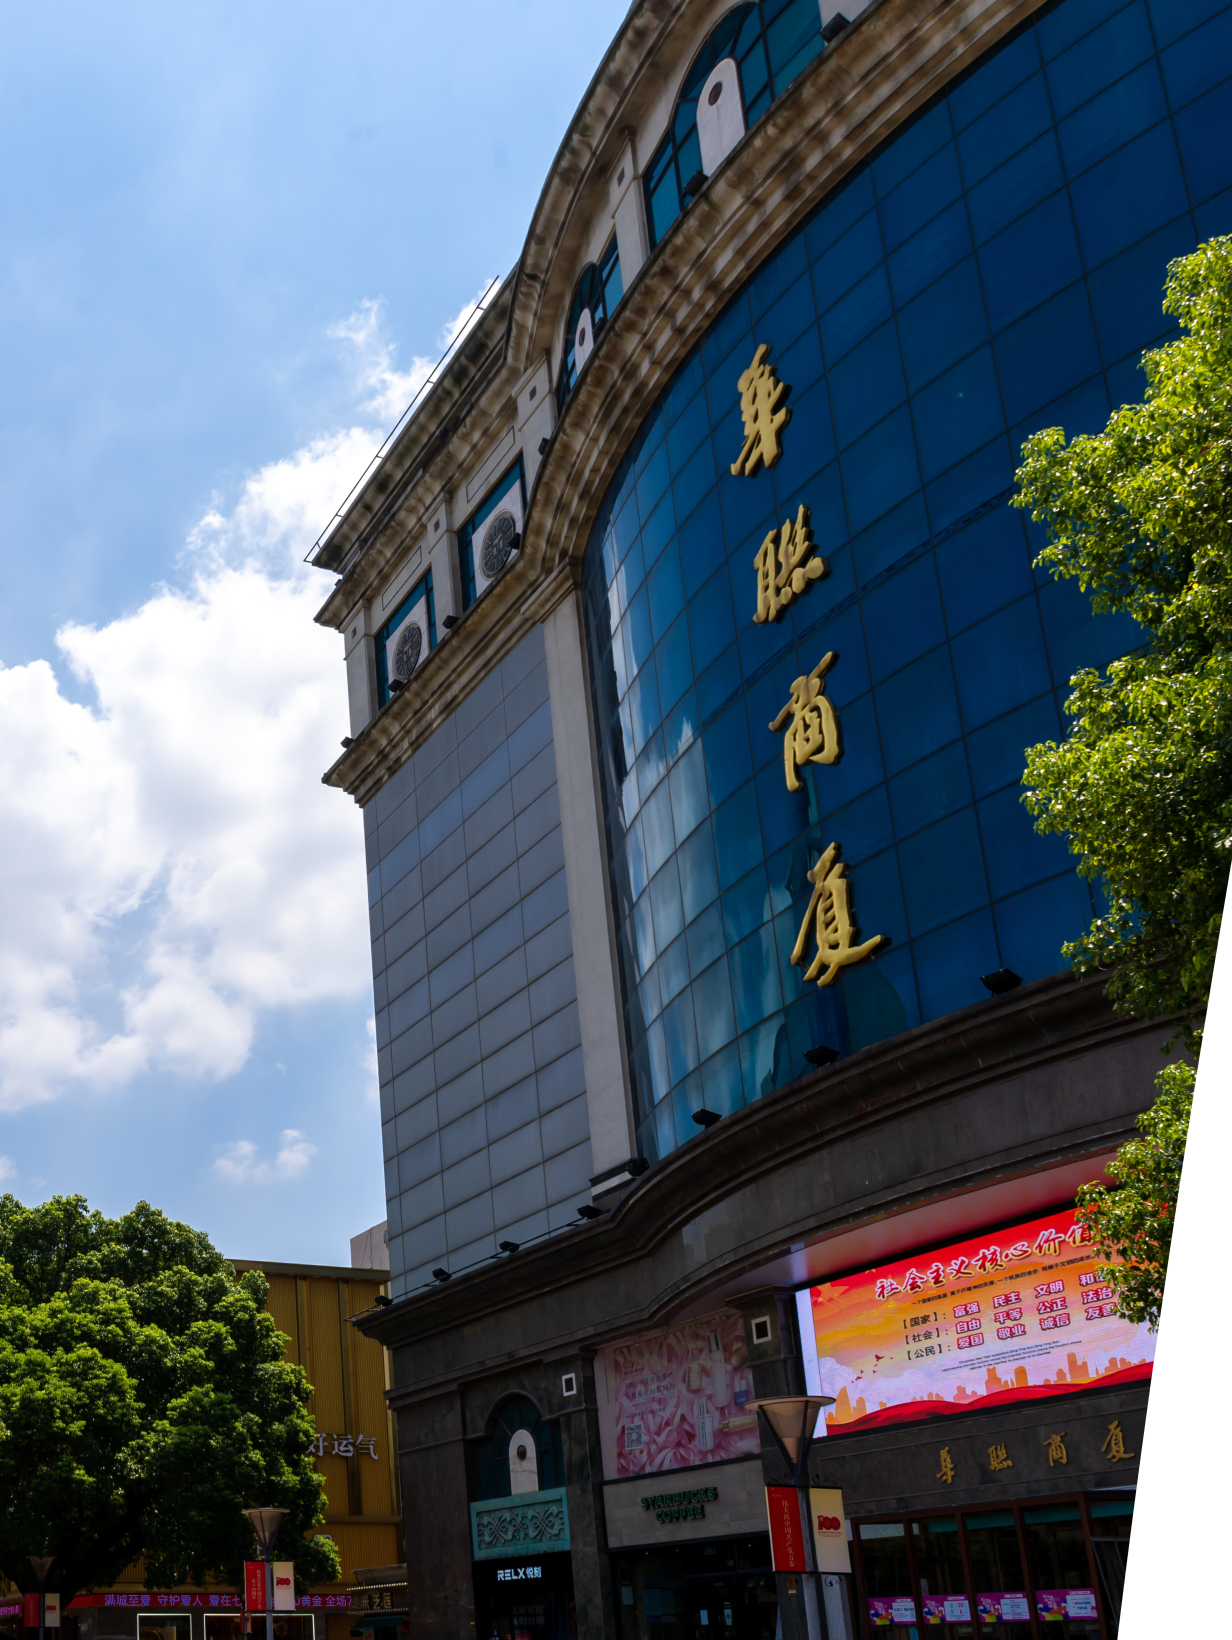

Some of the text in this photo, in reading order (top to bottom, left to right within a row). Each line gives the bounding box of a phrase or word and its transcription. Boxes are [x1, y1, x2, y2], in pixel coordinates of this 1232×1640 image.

[953, 1301, 980, 1318] 富强
[993, 1291, 1021, 1308] 民主
[1034, 1280, 1064, 1298] 文明
[955, 1318, 981, 1335] 自由
[994, 1307, 1023, 1325] 平等
[1036, 1297, 1067, 1315] 公正
[1081, 1286, 1113, 1305] 法治
[957, 1332, 984, 1350] 爱国
[996, 1323, 1026, 1340] 敬业
[1039, 1313, 1070, 1331] 诚信
[640, 1487, 717, 1509] STARBUCKS
[655, 1505, 704, 1523] COFFEE
[817, 1515, 841, 1531] 100
[782, 1499, 795, 1568] 伟大的中国共产党万岁
[497, 1566, 542, 1581] RELX 悦刻
[104, 1594, 151, 1606] 满城至爱
[157, 1594, 203, 1606] 守护爱人
